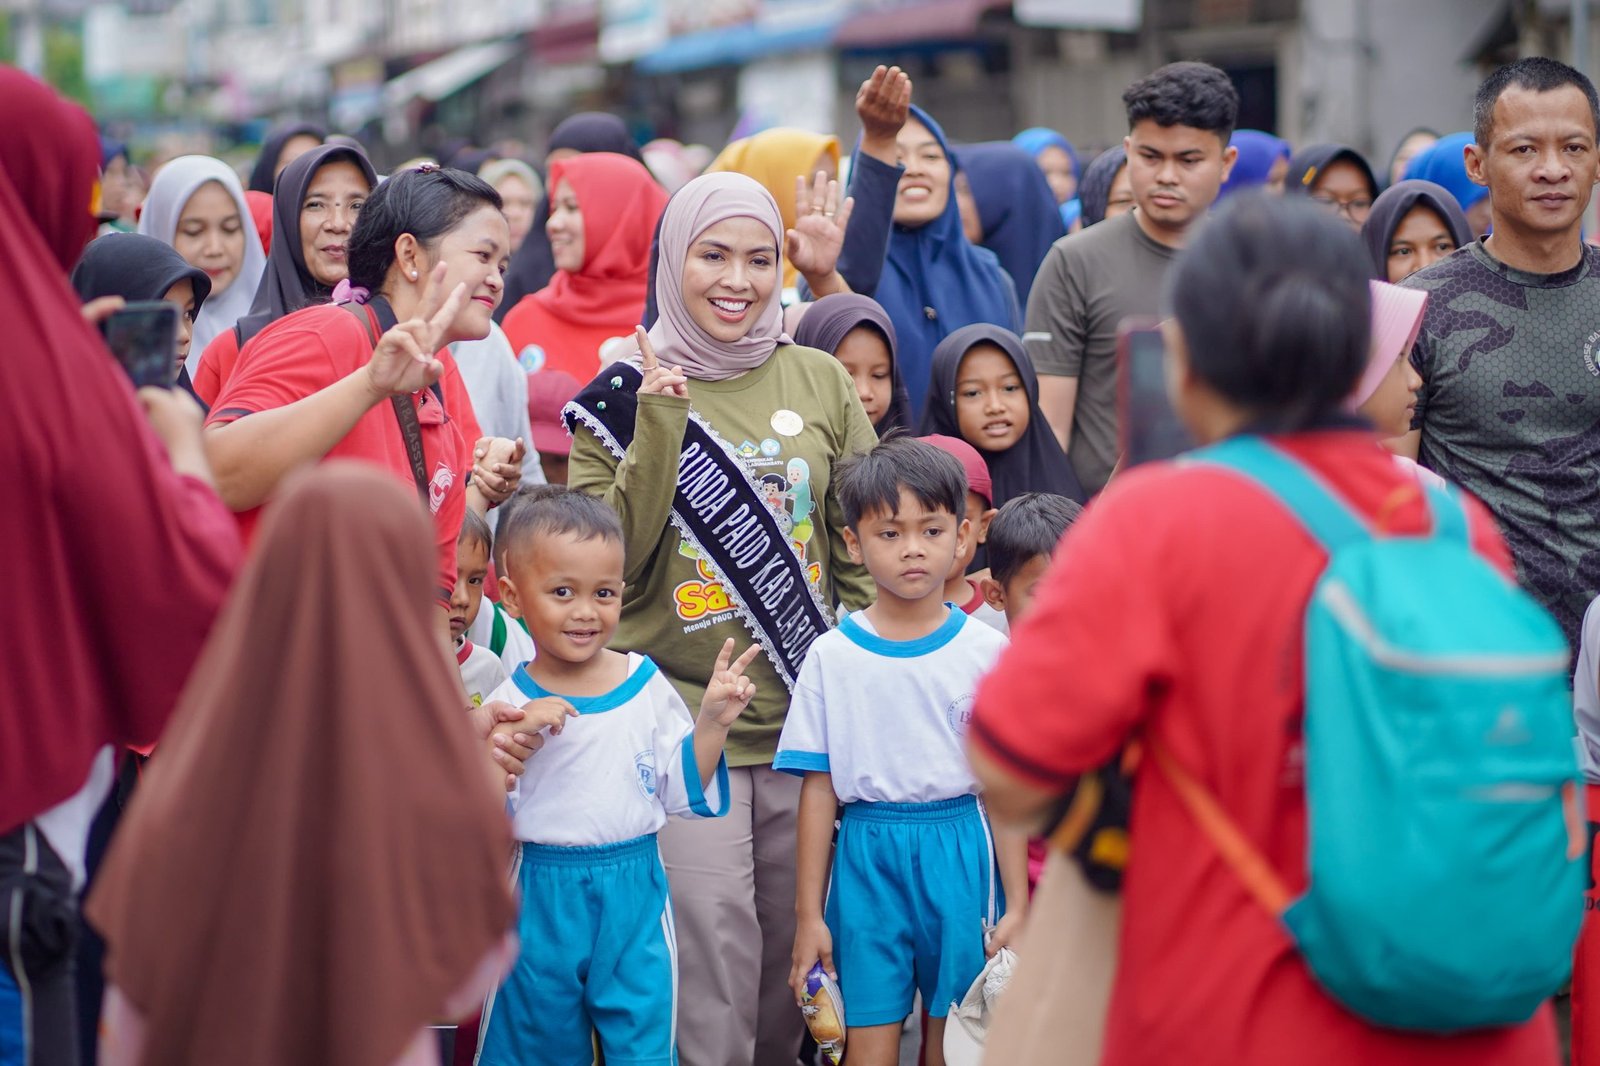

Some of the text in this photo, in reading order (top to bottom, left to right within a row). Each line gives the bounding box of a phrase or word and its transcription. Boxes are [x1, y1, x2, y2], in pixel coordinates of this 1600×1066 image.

[1584, 330, 1600, 376] COURSE BA
[676, 441, 737, 524] BUNDA
[711, 503, 771, 569] PAUD
[748, 552, 795, 616] KAB.
[683, 619, 711, 634] Menuju
[712, 612, 733, 625] PAUD
